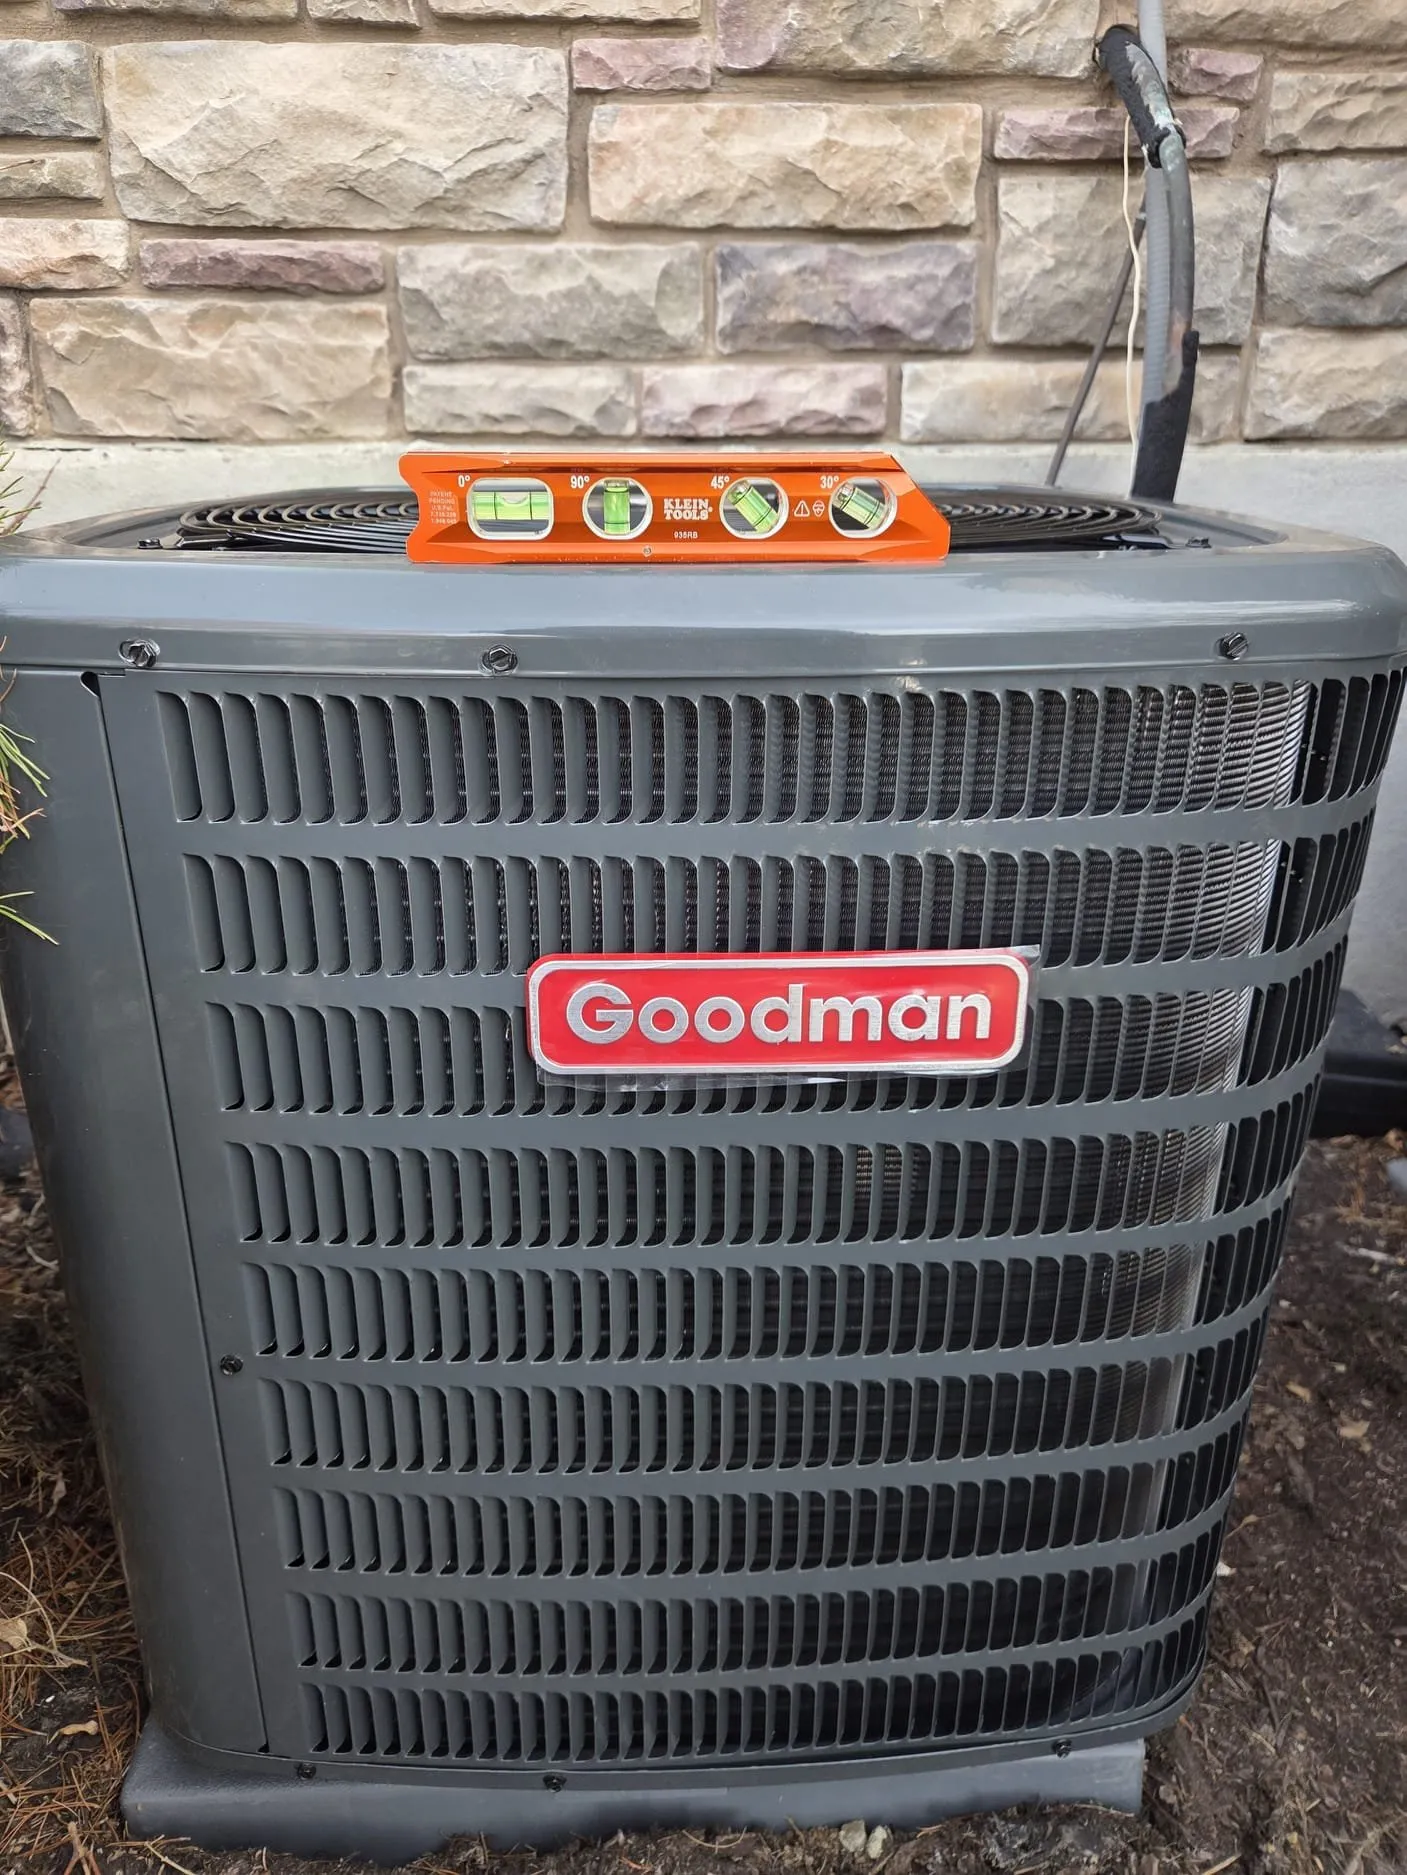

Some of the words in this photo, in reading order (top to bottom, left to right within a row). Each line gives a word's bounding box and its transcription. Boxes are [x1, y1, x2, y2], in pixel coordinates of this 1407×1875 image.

[458, 475, 470, 488] 0°
[570, 475, 590, 489] 90°
[711, 475, 730, 489] 45°
[820, 475, 839, 489] 30°
[663, 498, 709, 509] KLEIN
[674, 531, 698, 539] 935RB
[565, 983, 991, 1045] Goodman
